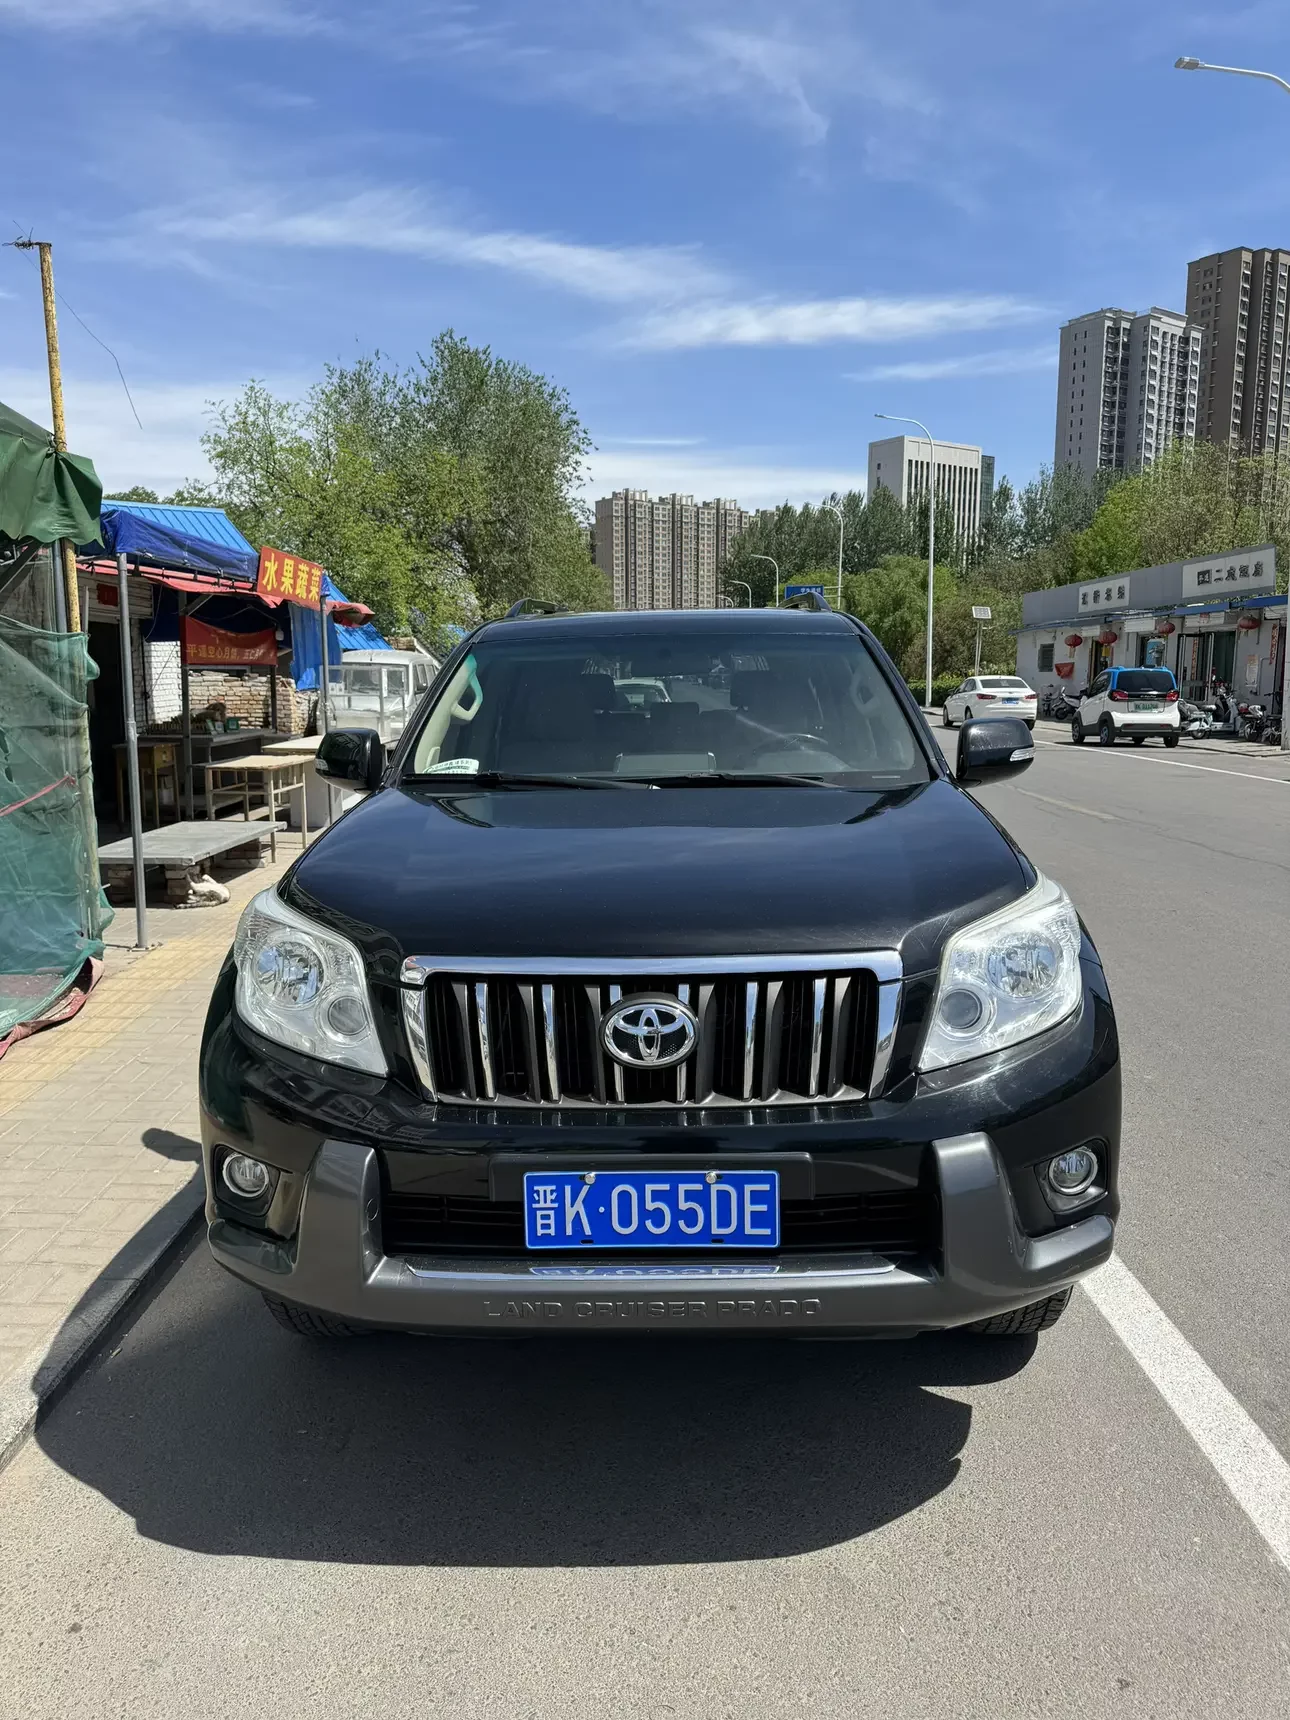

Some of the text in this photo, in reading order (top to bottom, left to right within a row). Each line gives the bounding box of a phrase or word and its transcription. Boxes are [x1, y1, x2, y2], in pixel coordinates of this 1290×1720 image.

[262, 552, 321, 602] 水果蔬菜
[484, 1298, 823, 1317] LAND CRUISER PRADO
